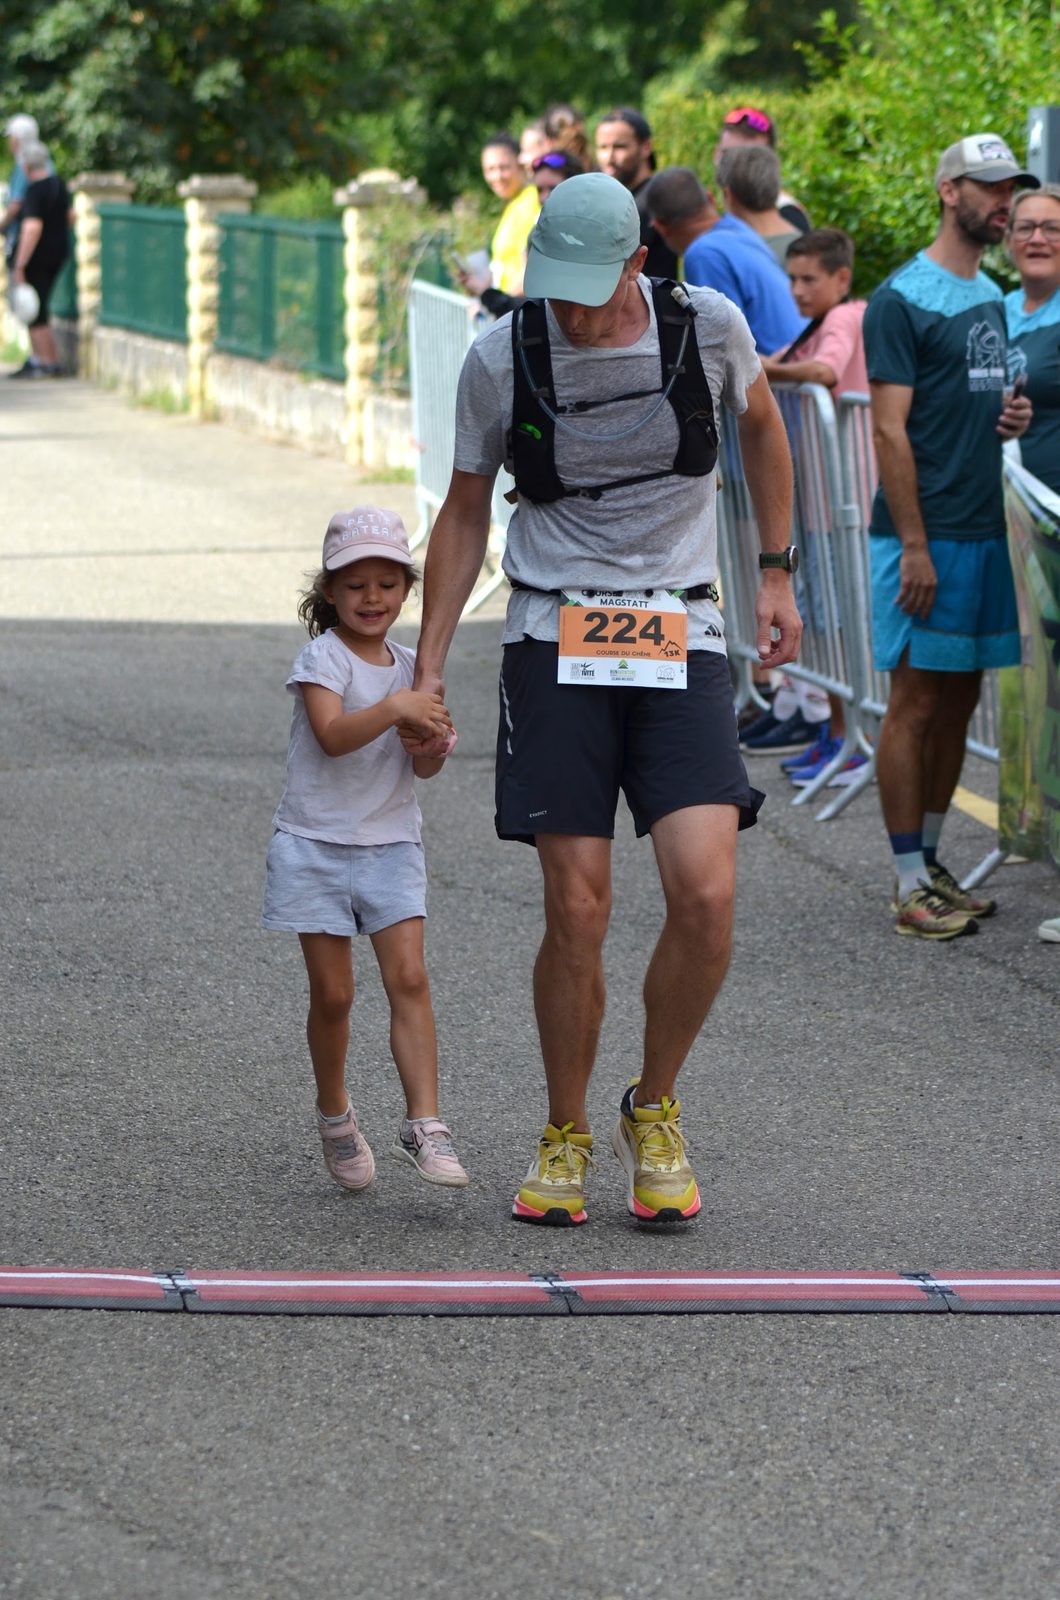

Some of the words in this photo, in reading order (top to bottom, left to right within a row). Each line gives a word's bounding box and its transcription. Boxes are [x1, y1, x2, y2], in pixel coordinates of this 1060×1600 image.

[599, 598, 649, 609] MAGSTATT
[583, 611, 665, 646] 224
[664, 649, 681, 657] 13K
